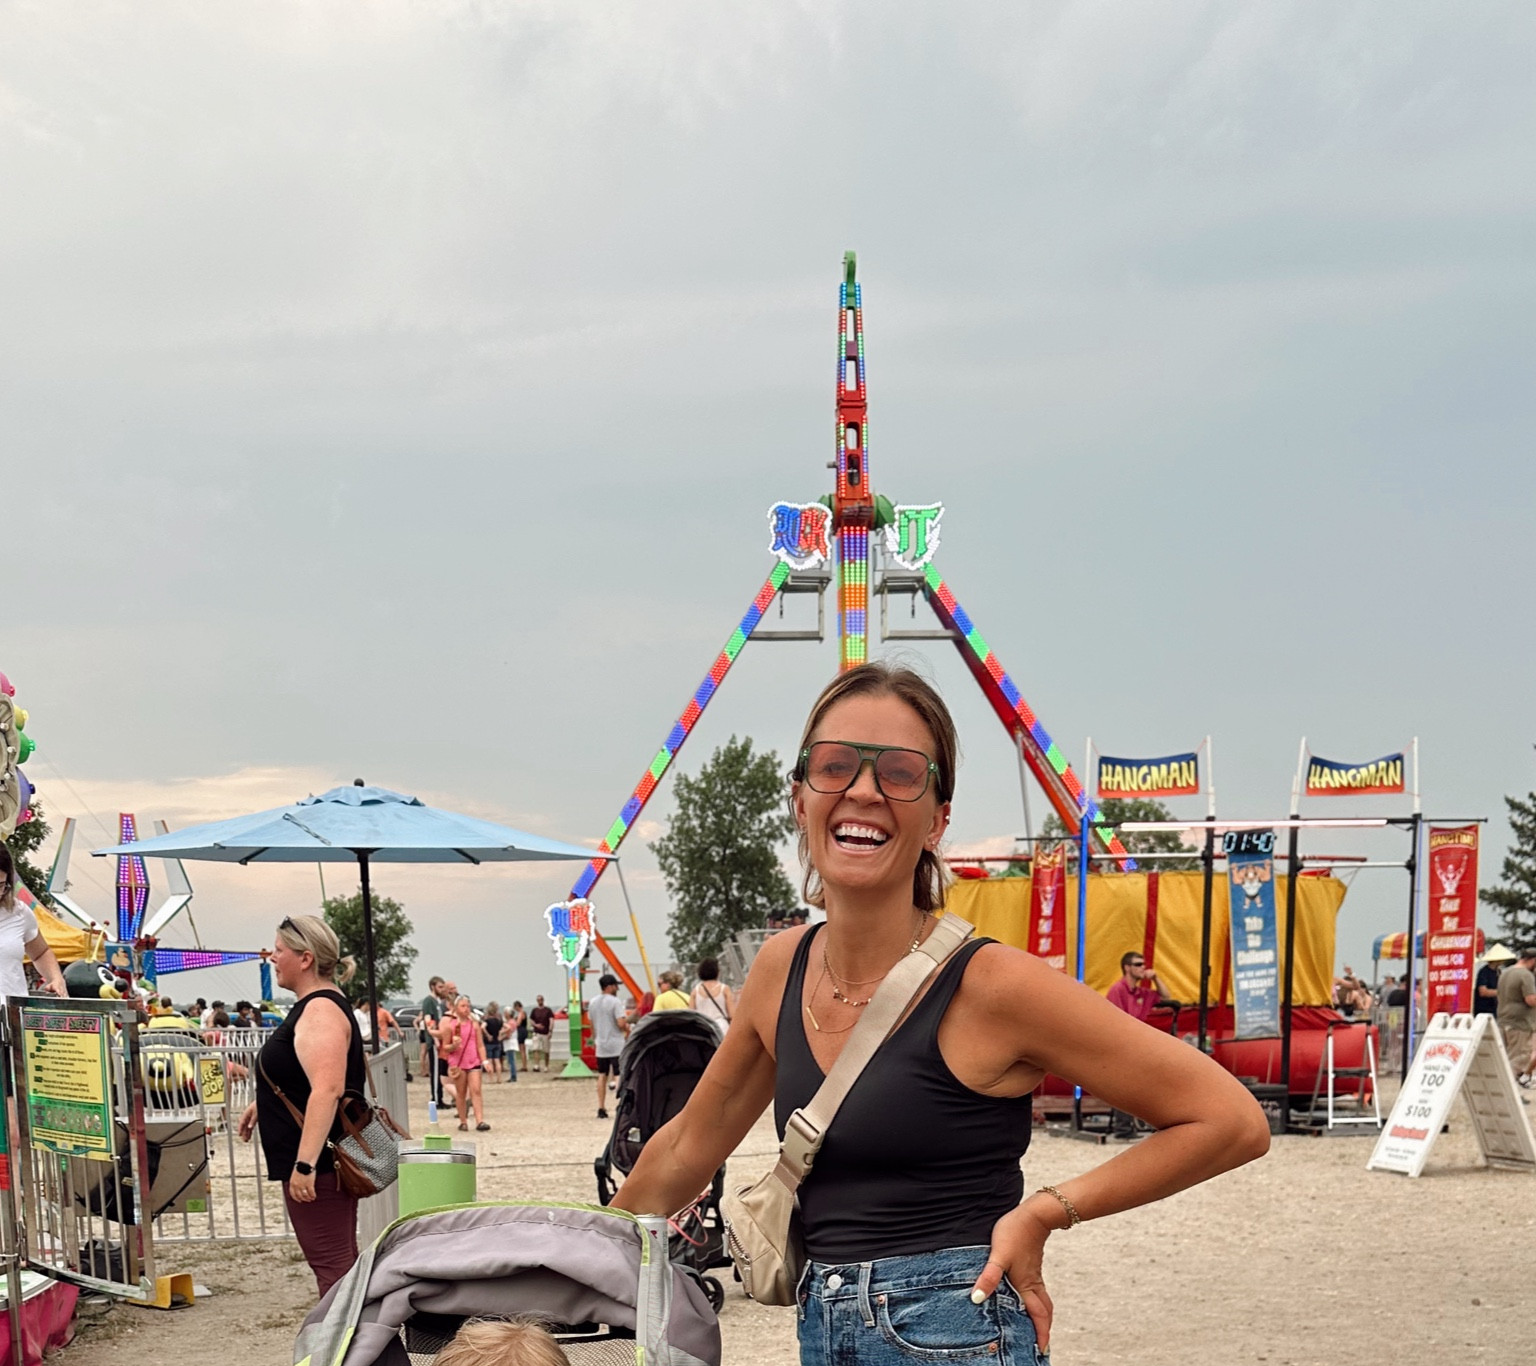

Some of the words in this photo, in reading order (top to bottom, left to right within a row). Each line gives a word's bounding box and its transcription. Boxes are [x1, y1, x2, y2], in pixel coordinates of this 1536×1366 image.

[1101, 761, 1196, 791] HANGMAN
[1308, 761, 1402, 790] HANGMAN
[1223, 832, 1274, 852] 01:40
[1420, 1073, 1445, 1087] 100
[1405, 1105, 1432, 1118] $100
